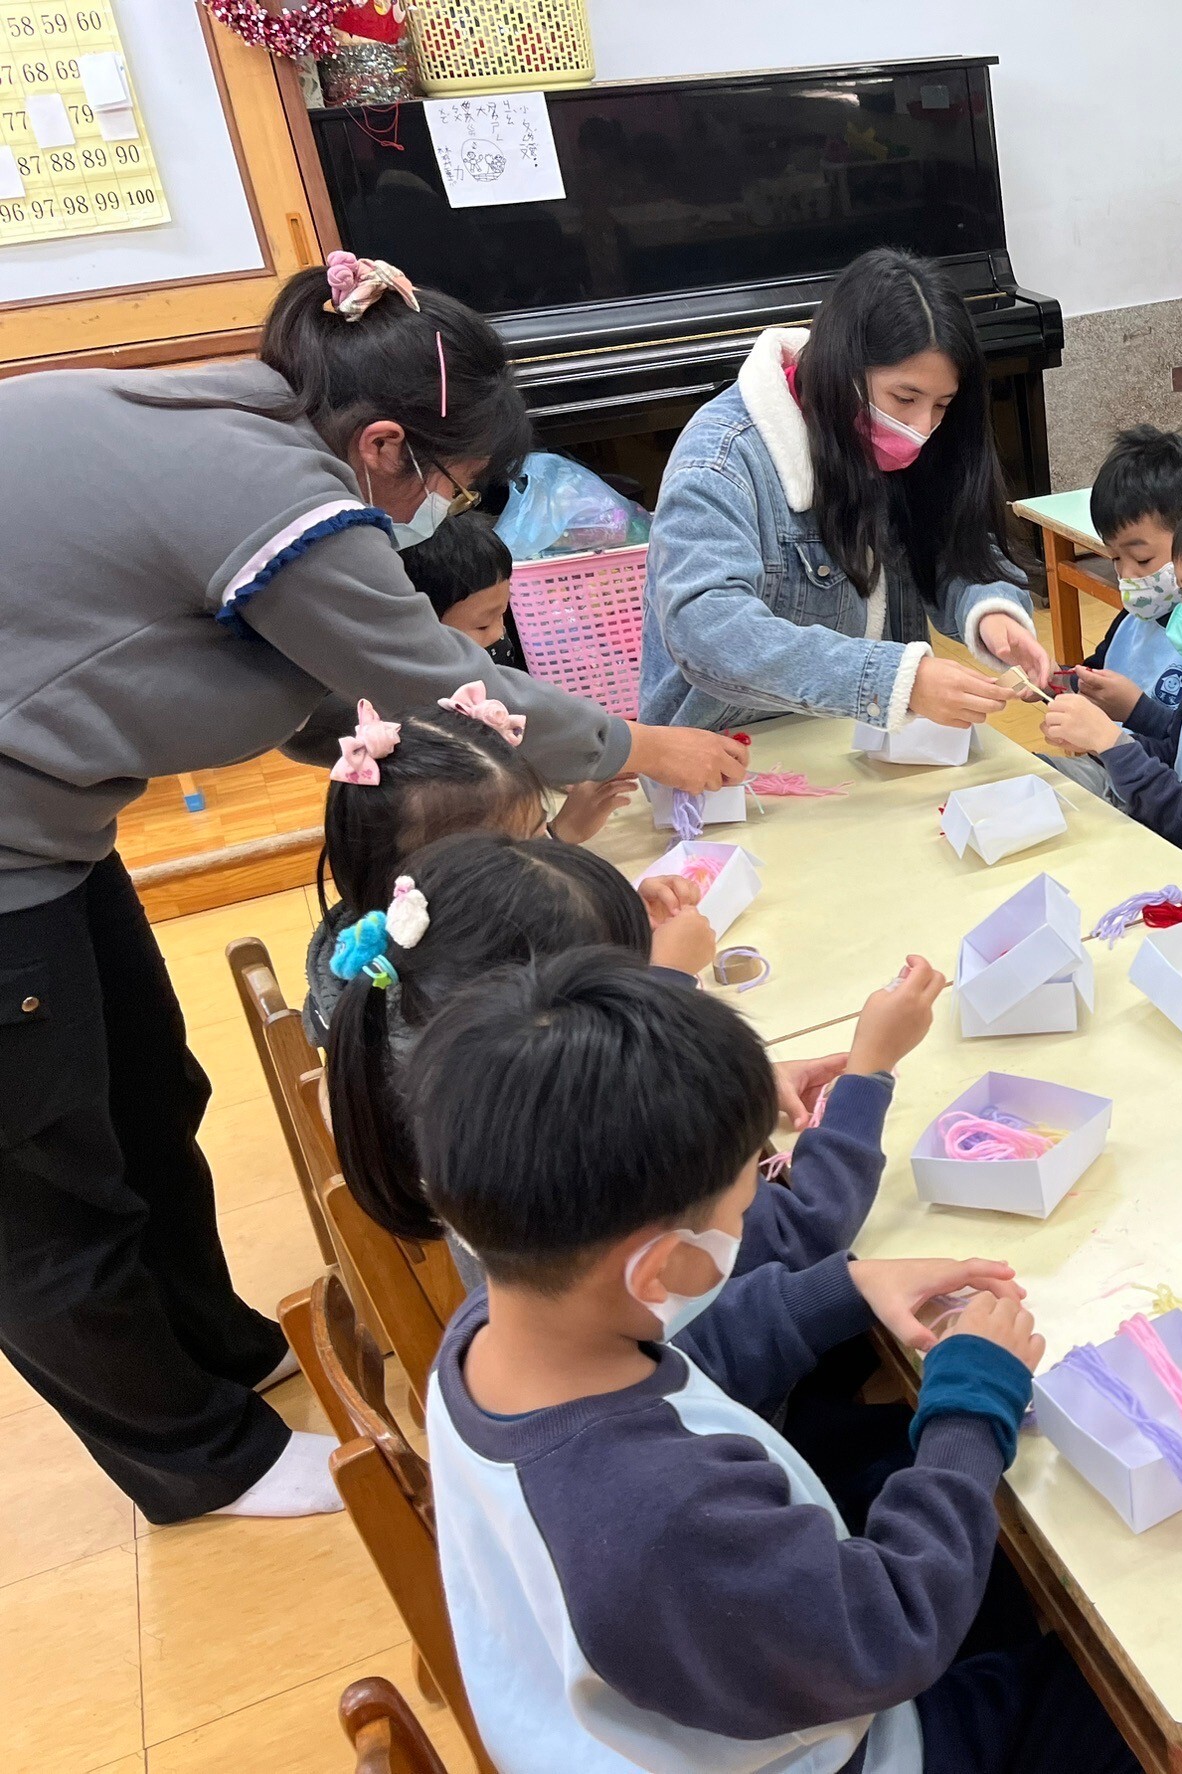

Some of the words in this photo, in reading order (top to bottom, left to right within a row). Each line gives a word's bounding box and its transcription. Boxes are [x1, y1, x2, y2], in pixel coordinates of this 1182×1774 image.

[7, 16, 35, 37] 58
[41, 13, 68, 34] 59
[76, 10, 102, 32] 60
[0, 65, 12, 84] 7
[22, 62, 49, 83] 68
[55, 59, 81, 80] 69
[2, 111, 27, 131] 77
[68, 104, 95, 125] 79
[17, 156, 41, 176] 87
[51, 152, 76, 172] 88
[82, 148, 107, 168] 89
[115, 144, 140, 164] 90
[0, 204, 25, 223] 96
[31, 199, 54, 219] 97
[63, 195, 89, 215] 98
[95, 191, 120, 211] 99
[126, 189, 155, 206] 100
